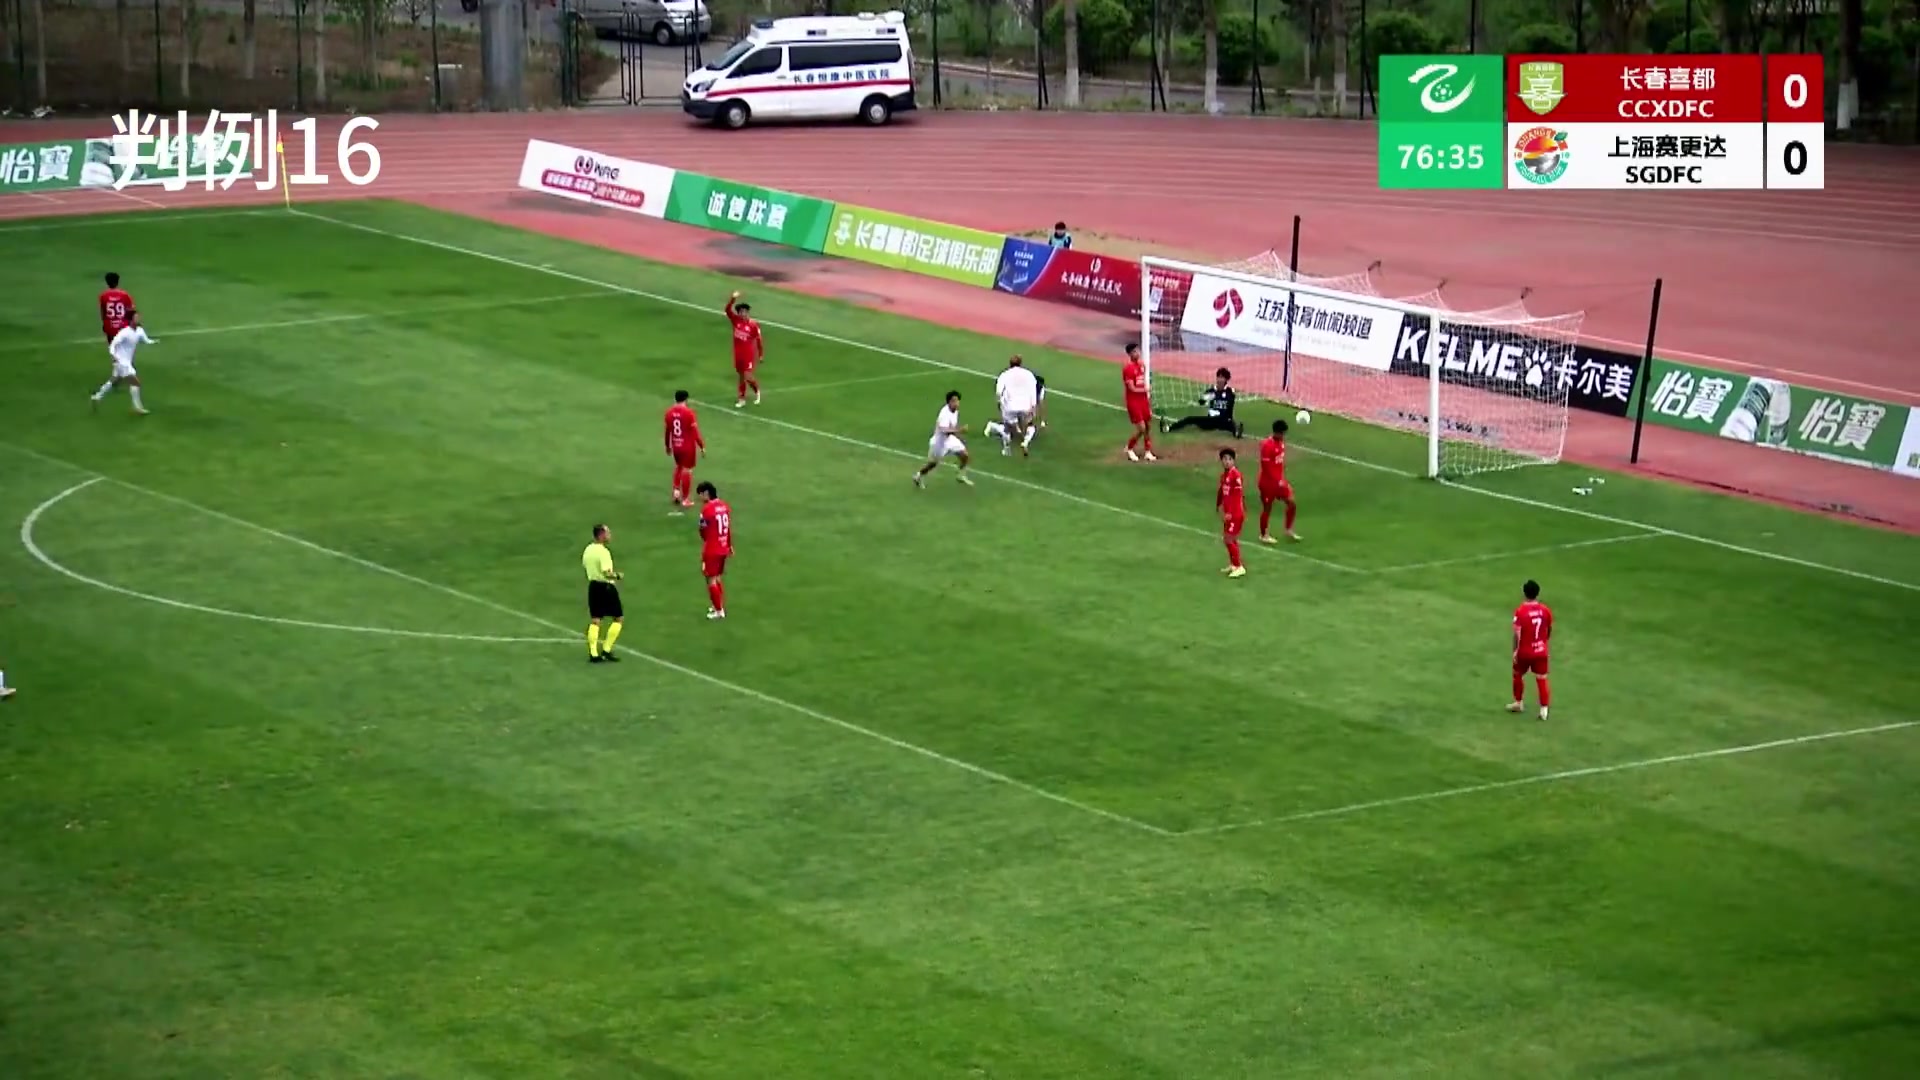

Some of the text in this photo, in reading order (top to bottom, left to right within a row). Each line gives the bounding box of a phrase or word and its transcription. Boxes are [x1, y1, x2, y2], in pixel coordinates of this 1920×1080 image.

[706, 190, 787, 231] 诚信联赛
[854, 219, 999, 275] 长春喜都足球俱乐部
[105, 302, 126, 318] 59
[1397, 326, 1524, 381] KELME
[1553, 354, 1634, 403] 卡尔美
[672, 419, 682, 438] 8
[715, 513, 730, 535] 19
[1531, 617, 1542, 640] 7
